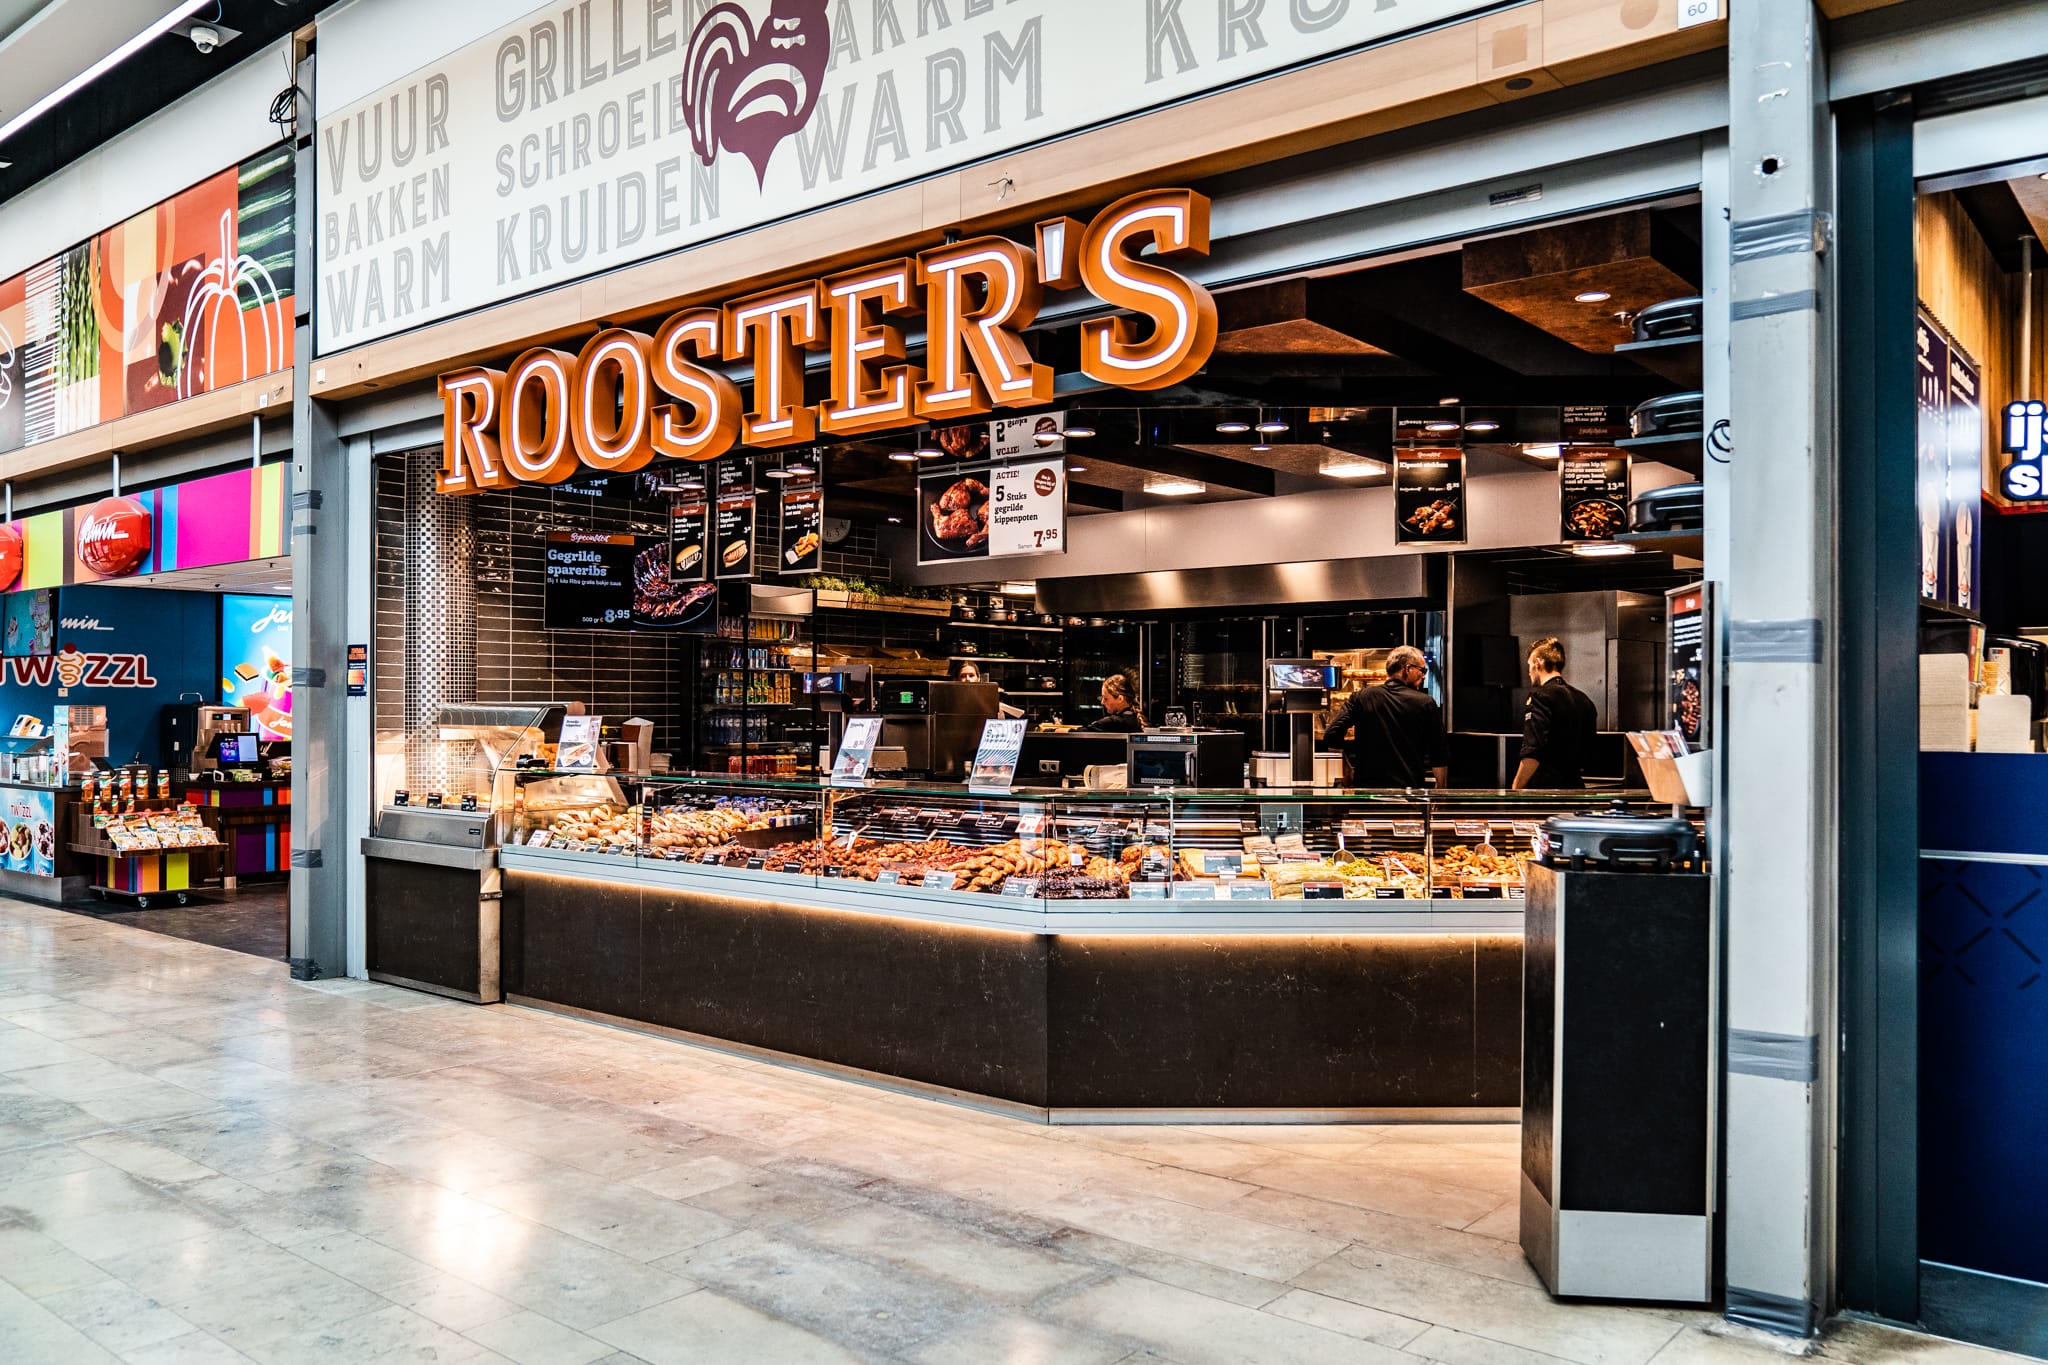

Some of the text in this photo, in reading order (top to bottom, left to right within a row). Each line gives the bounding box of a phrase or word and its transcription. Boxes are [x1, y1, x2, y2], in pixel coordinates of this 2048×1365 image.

[1688, 2, 1708, 17] 60
[794, 15, 1044, 191] WARM
[325, 71, 451, 196] VUUR
[325, 162, 451, 263] BAKKEN
[496, 150, 723, 286] KRUIDEN
[325, 232, 452, 339] WARM
[437, 187, 1218, 495] ROOSTER'S
[2009, 403, 2048, 460] ij
[995, 470, 1020, 480] ACTIE!
[995, 485, 1028, 502] 5 Stuks
[994, 503, 1024, 515] gegrilde
[994, 513, 1039, 525] kippenpoten
[1034, 528, 1058, 548] 7,95
[547, 548, 602, 564] Gegrilde
[547, 563, 608, 577] spareribs
[604, 608, 631, 623] 8,95
